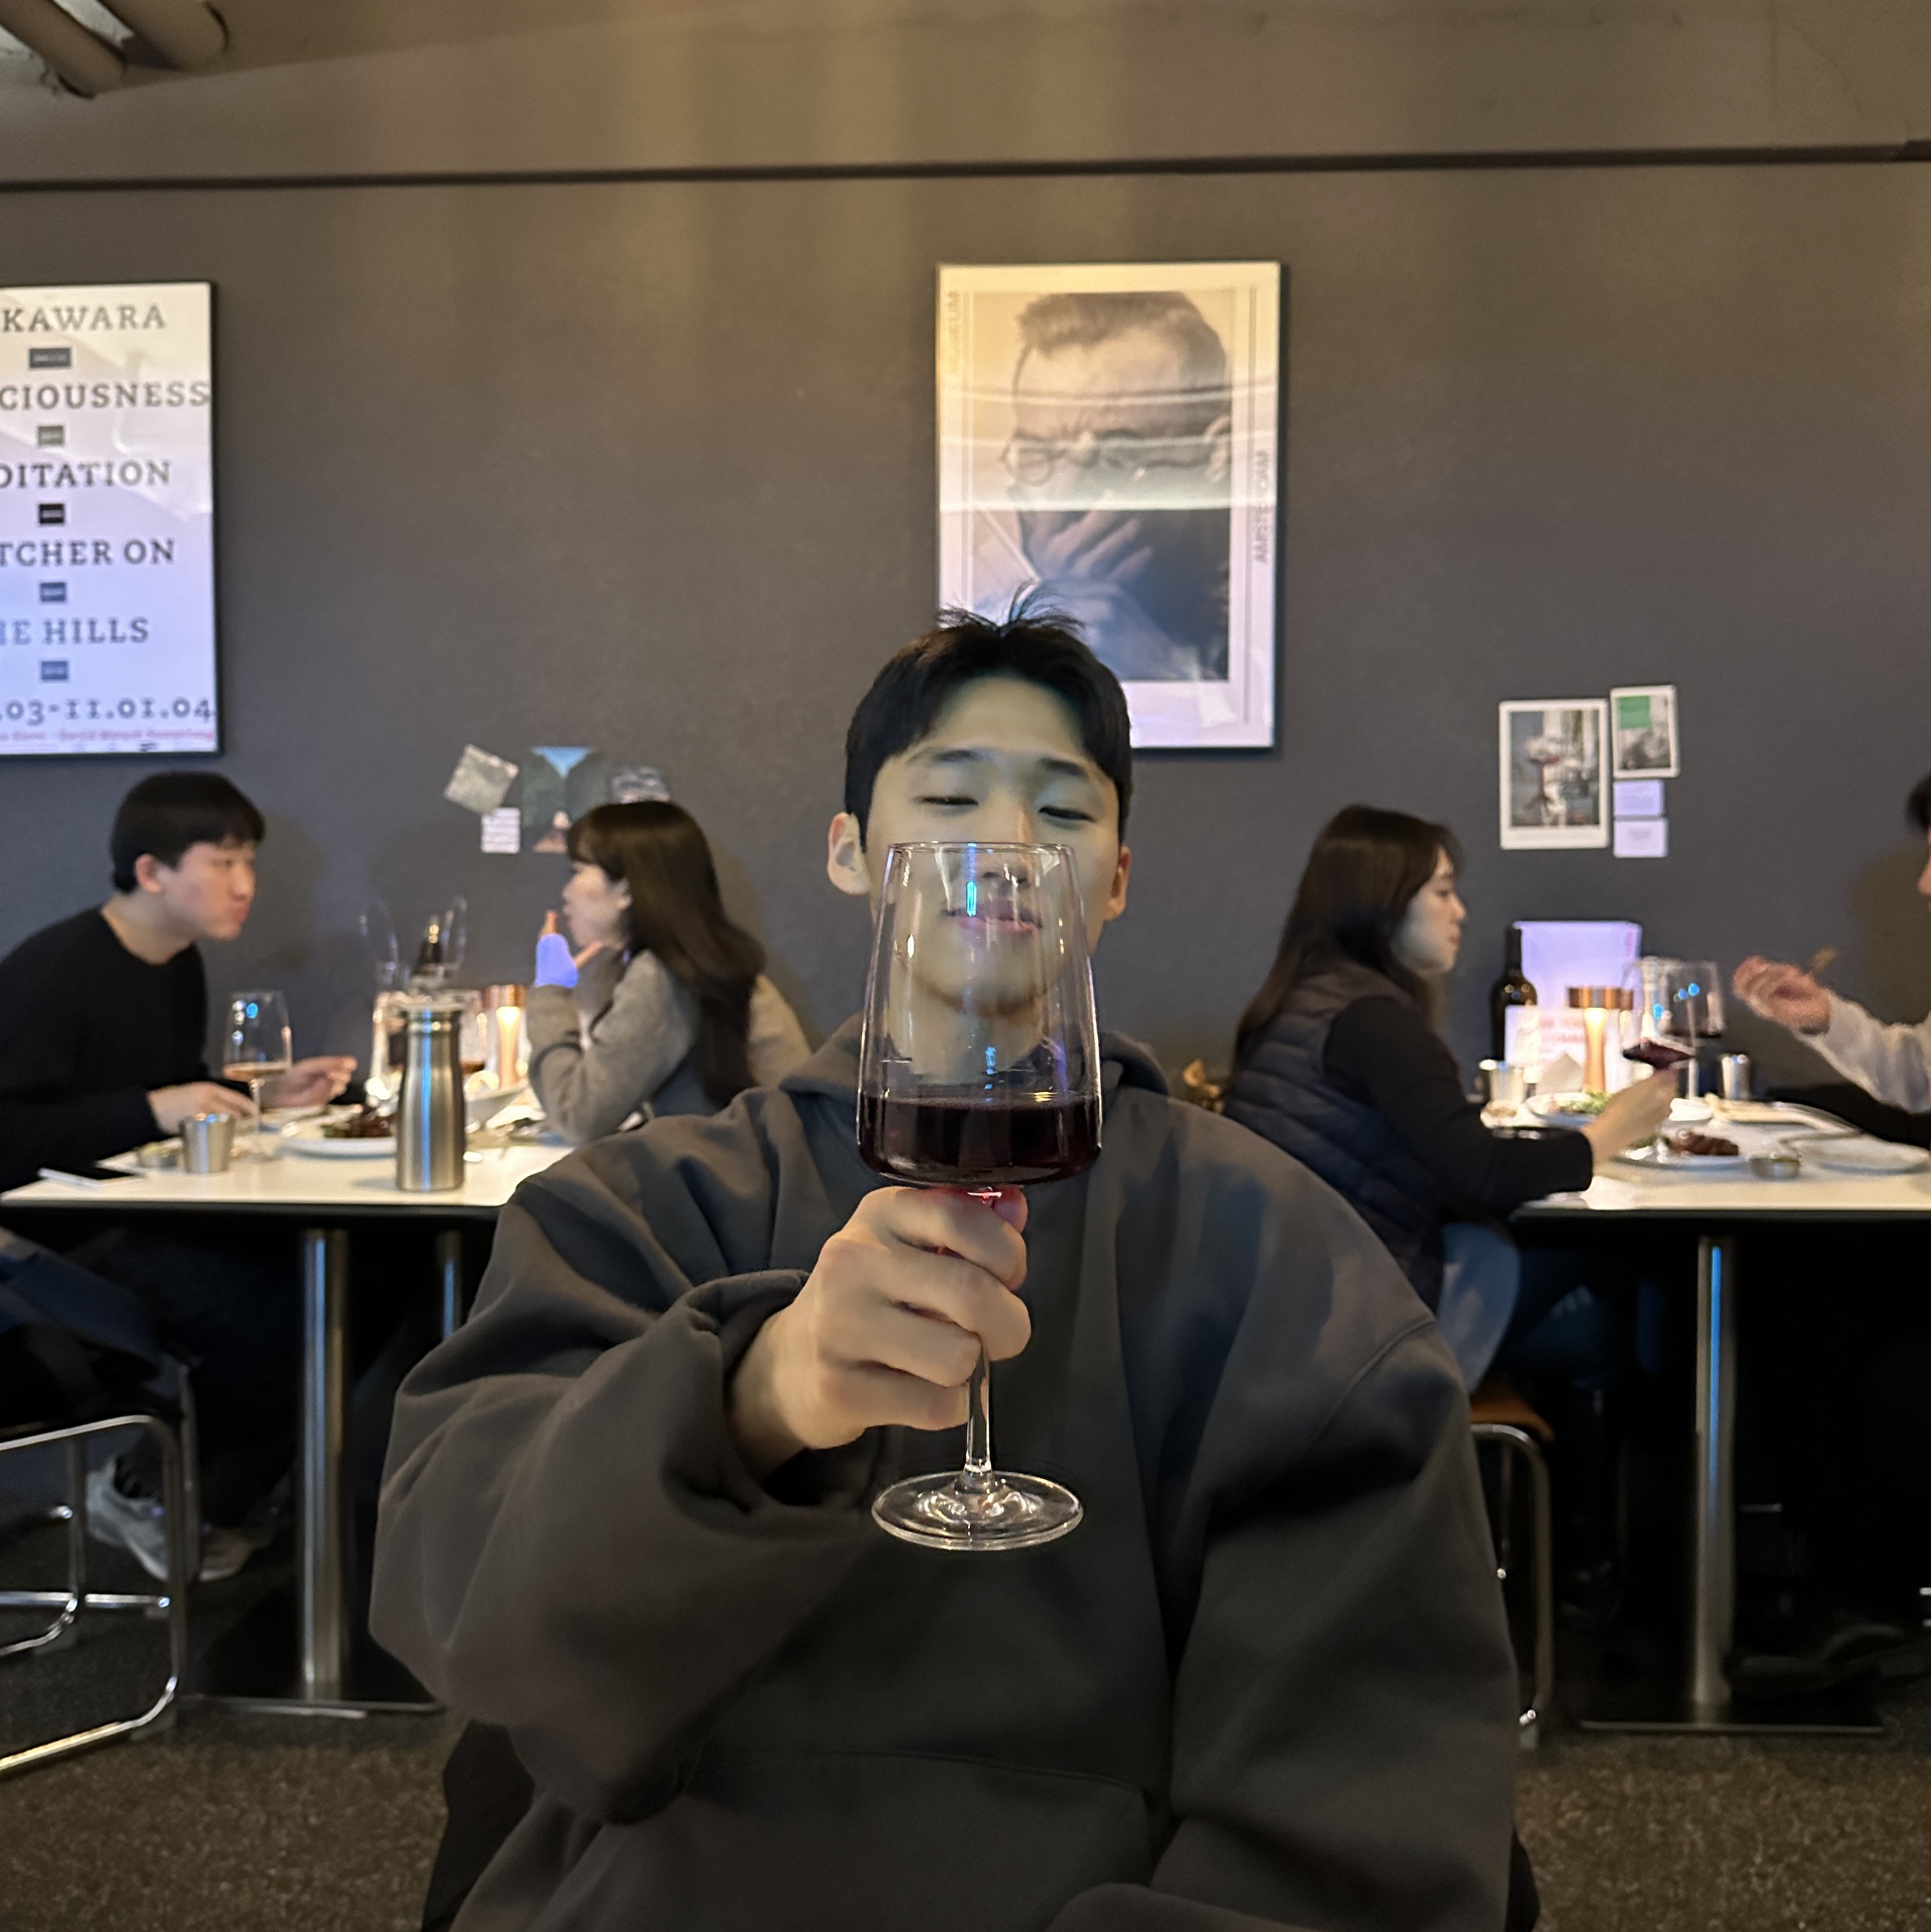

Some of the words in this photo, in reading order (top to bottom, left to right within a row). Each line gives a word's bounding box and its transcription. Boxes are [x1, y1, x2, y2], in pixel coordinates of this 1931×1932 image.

[2, 304, 166, 332] KAWARA
[0, 381, 209, 410] CIOUSNESS
[124, 538, 174, 565] ON
[43, 616, 149, 644] HILLS
